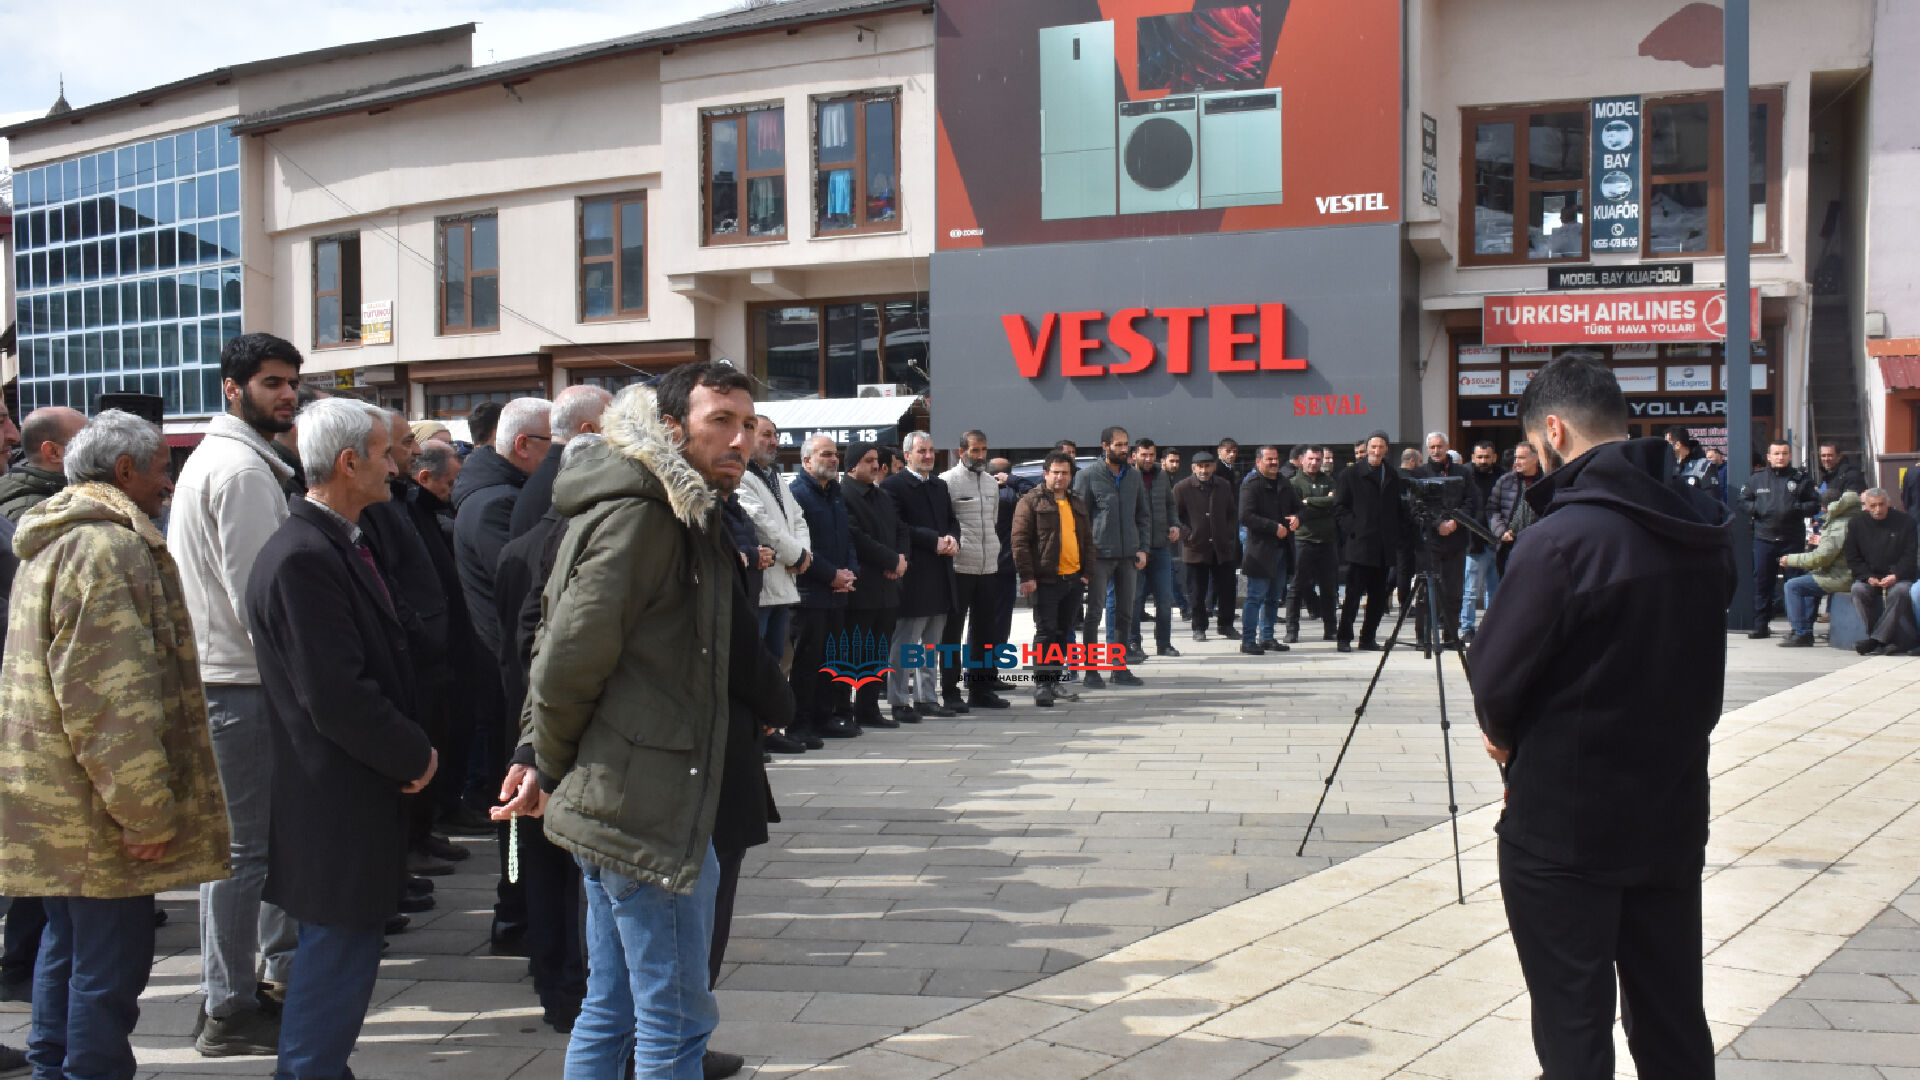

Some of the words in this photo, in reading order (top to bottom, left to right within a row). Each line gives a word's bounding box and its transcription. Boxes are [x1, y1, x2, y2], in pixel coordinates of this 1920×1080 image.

[1595, 101, 1639, 118] MODEL
[1603, 153, 1631, 169] BAY
[1315, 192, 1388, 214] VESTEL
[1593, 201, 1639, 219] KUAFÖR
[1560, 272, 1599, 286] MODEL
[1602, 271, 1624, 284] BAY
[1626, 266, 1680, 284] KUAFÖRÜ
[1492, 303, 1590, 325] TURKISH
[1595, 300, 1695, 322] AIRLINES
[1584, 324, 1612, 335] TÜRK
[1616, 324, 1647, 334] HAVA
[1651, 323, 1696, 334] YOLLARI
[1001, 302, 1308, 378] VESTEL
[1293, 394, 1367, 416] SEVAL
[1488, 401, 1518, 417] TÜ
[857, 429, 878, 442] 13
